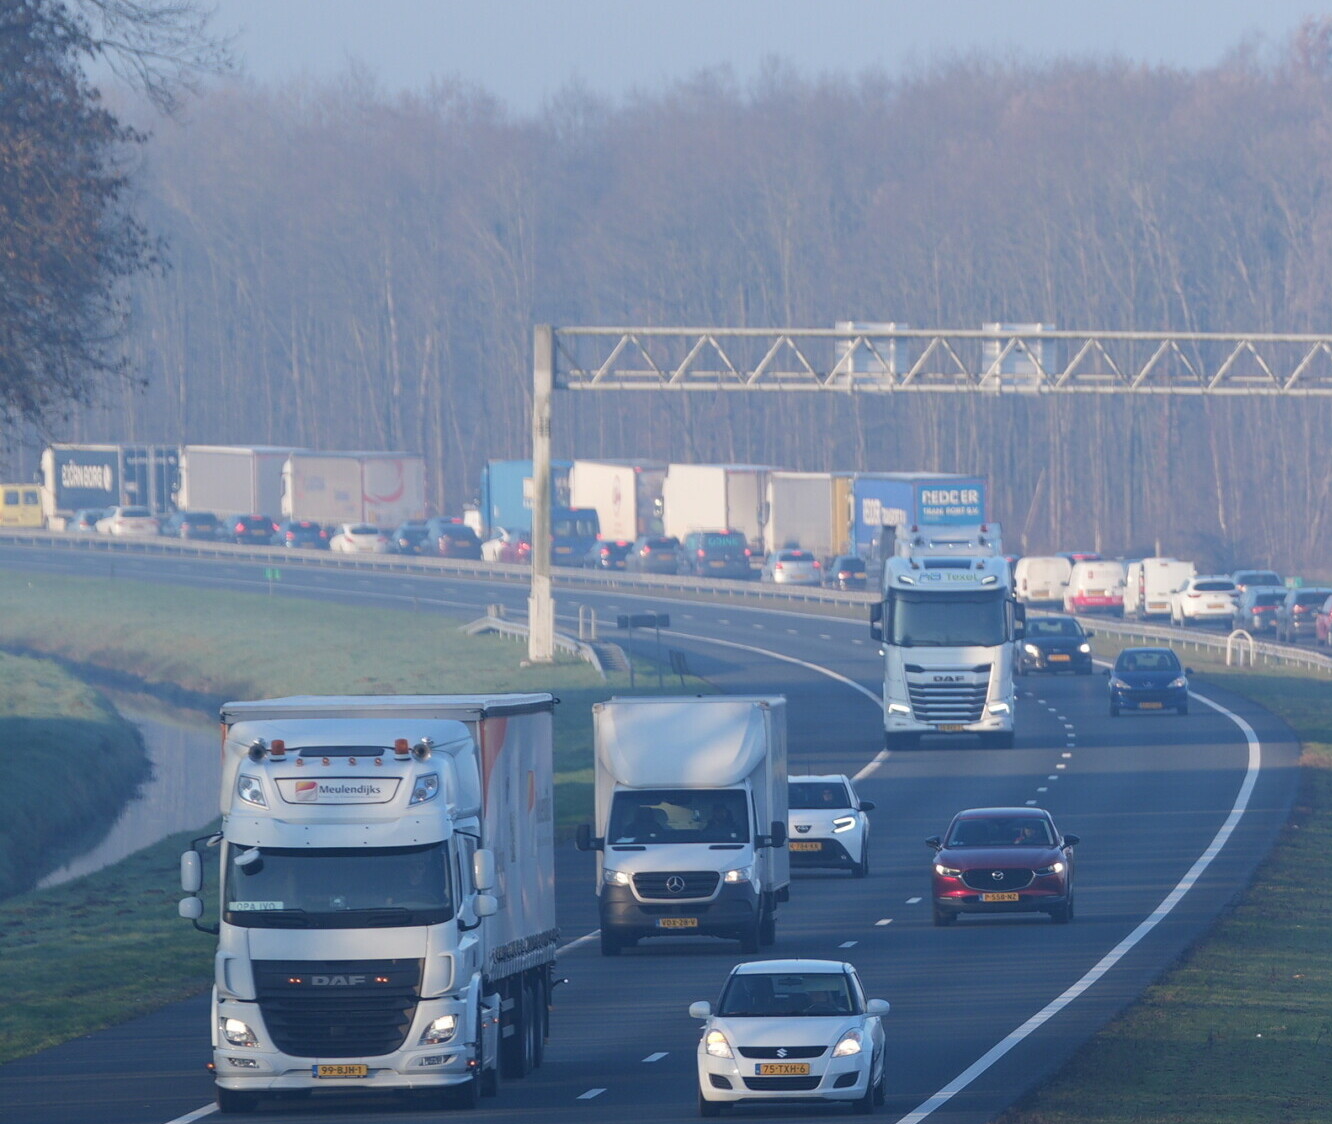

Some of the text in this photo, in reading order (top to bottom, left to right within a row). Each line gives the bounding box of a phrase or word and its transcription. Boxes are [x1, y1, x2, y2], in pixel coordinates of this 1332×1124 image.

[319, 785, 381, 795] Meulendijks
[312, 976, 366, 985] DAF
[321, 1066, 362, 1074] 99-BJH-1
[763, 1065, 806, 1073] 75-TXH-6
